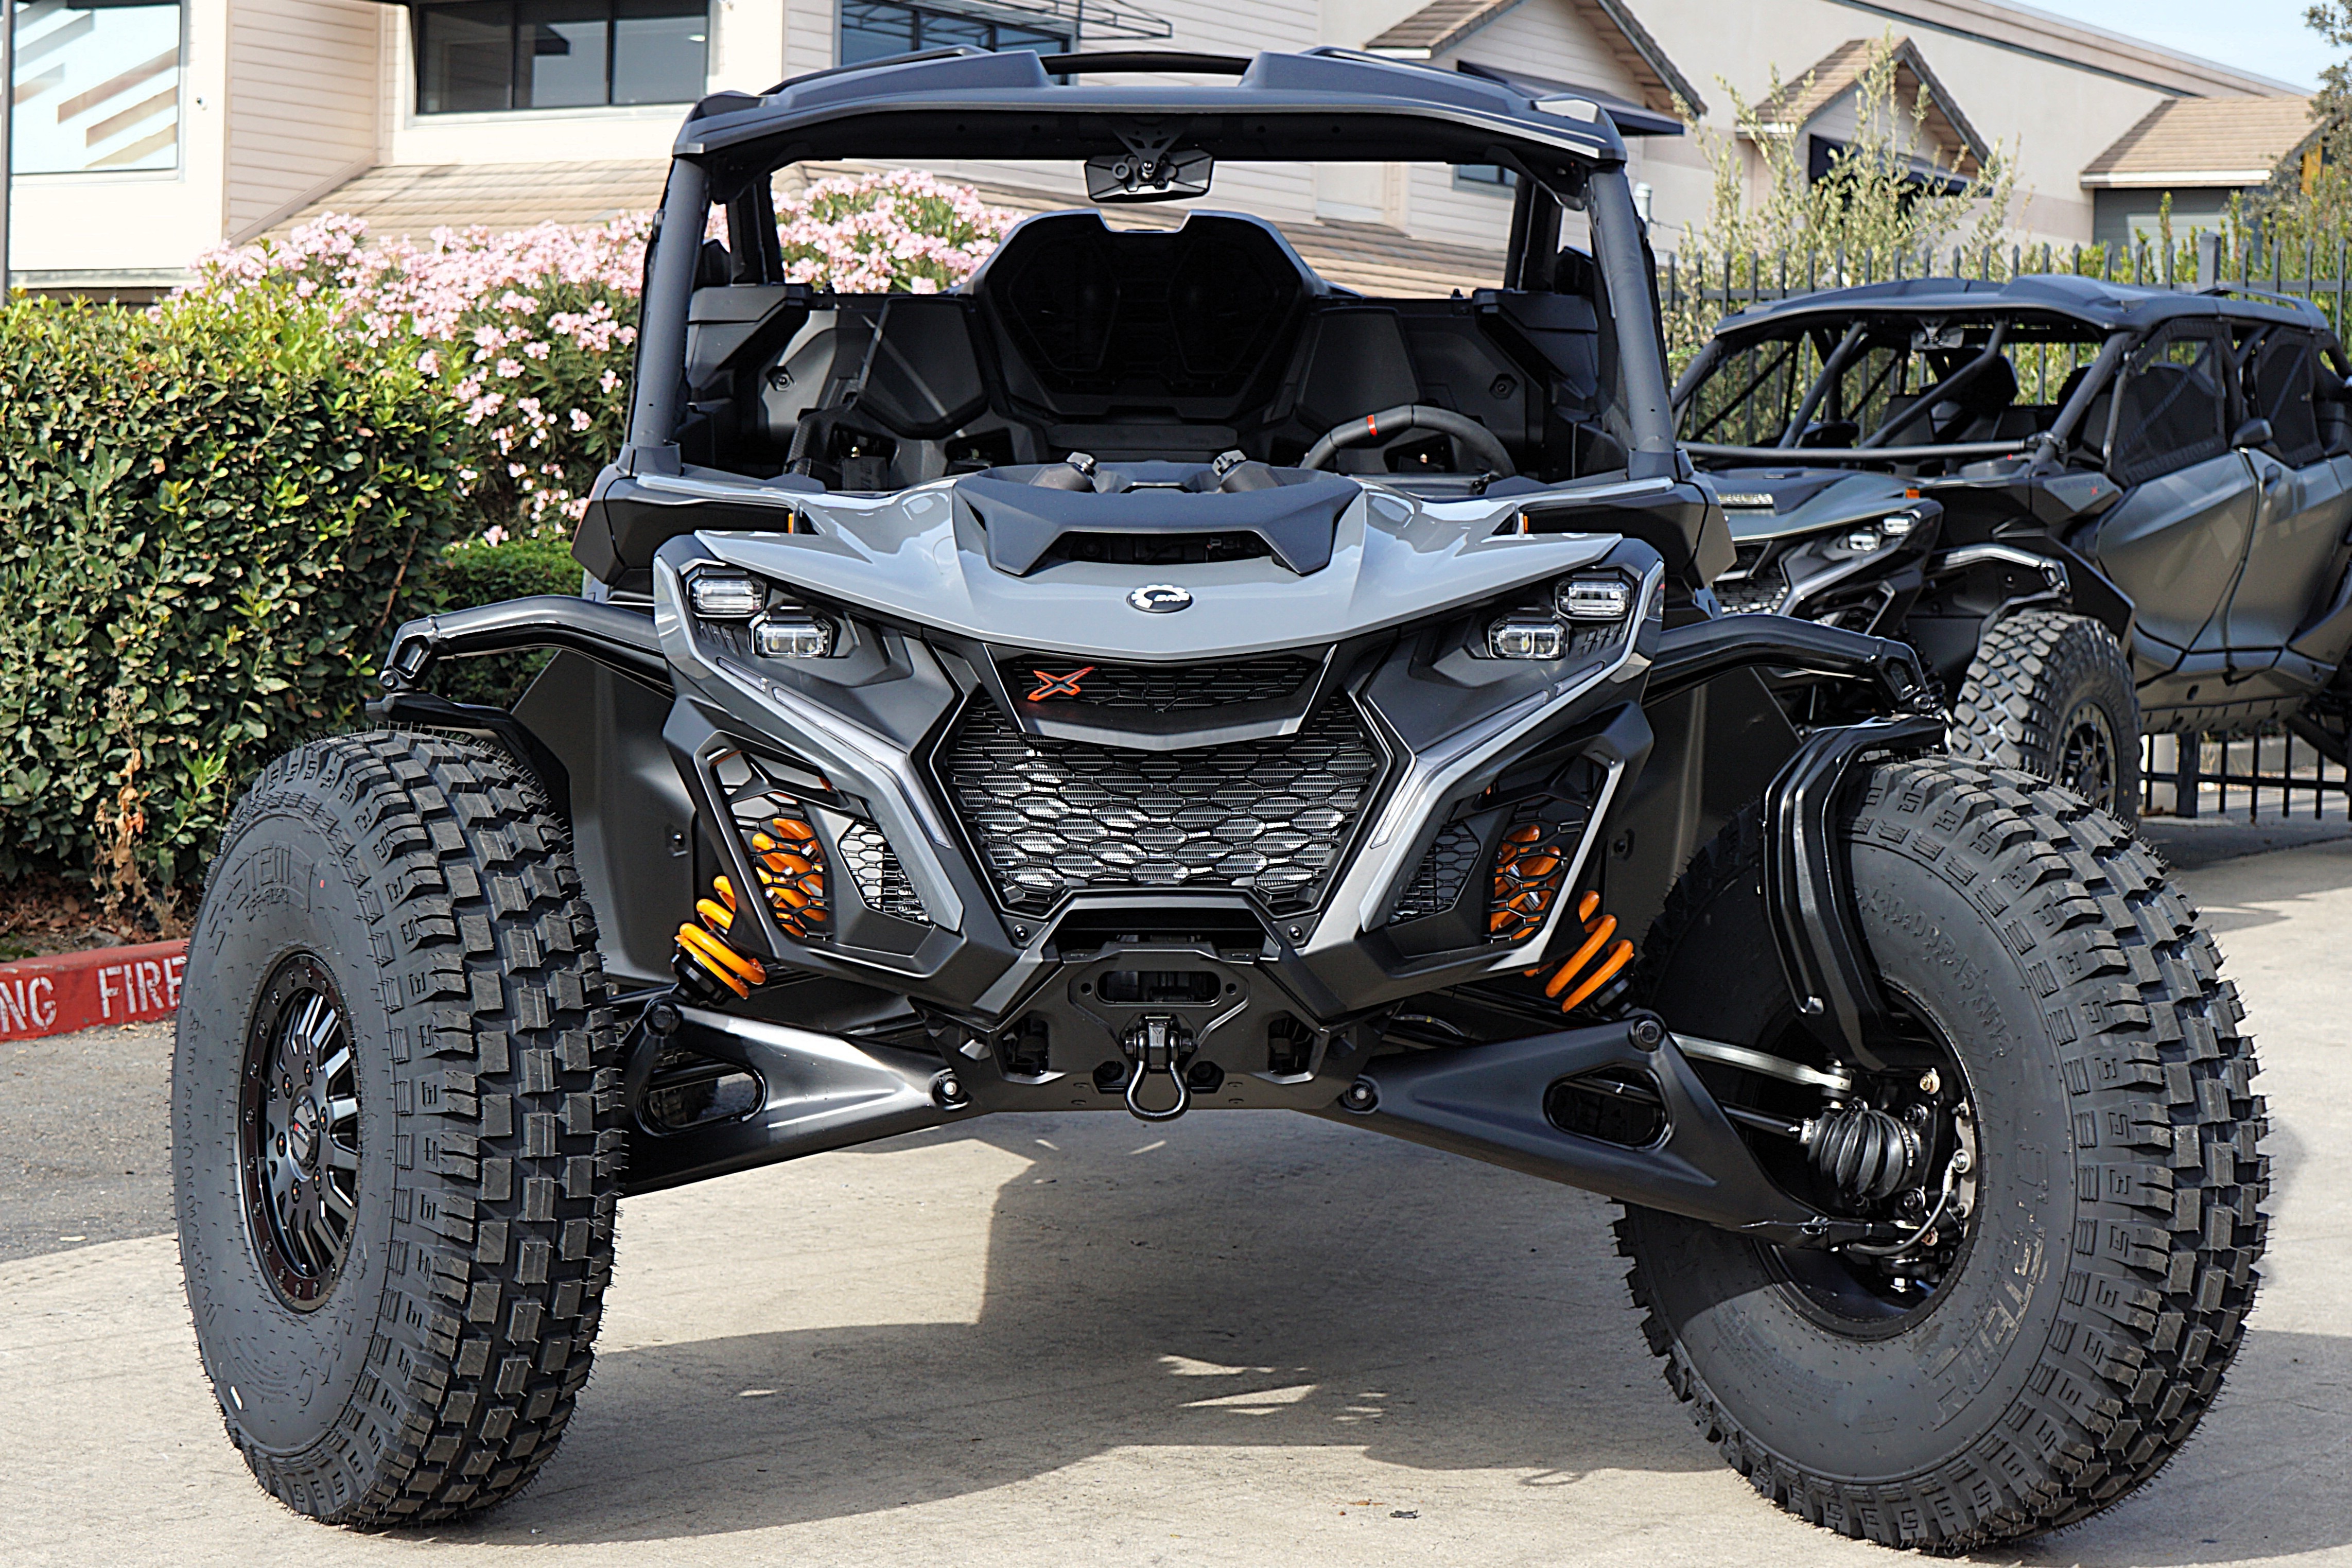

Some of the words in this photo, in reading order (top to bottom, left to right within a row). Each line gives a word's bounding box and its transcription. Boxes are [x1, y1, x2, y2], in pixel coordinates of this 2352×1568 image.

[1027, 667, 1095, 701] X
[0, 977, 57, 1033] NG
[98, 956, 187, 1018] FIRE
